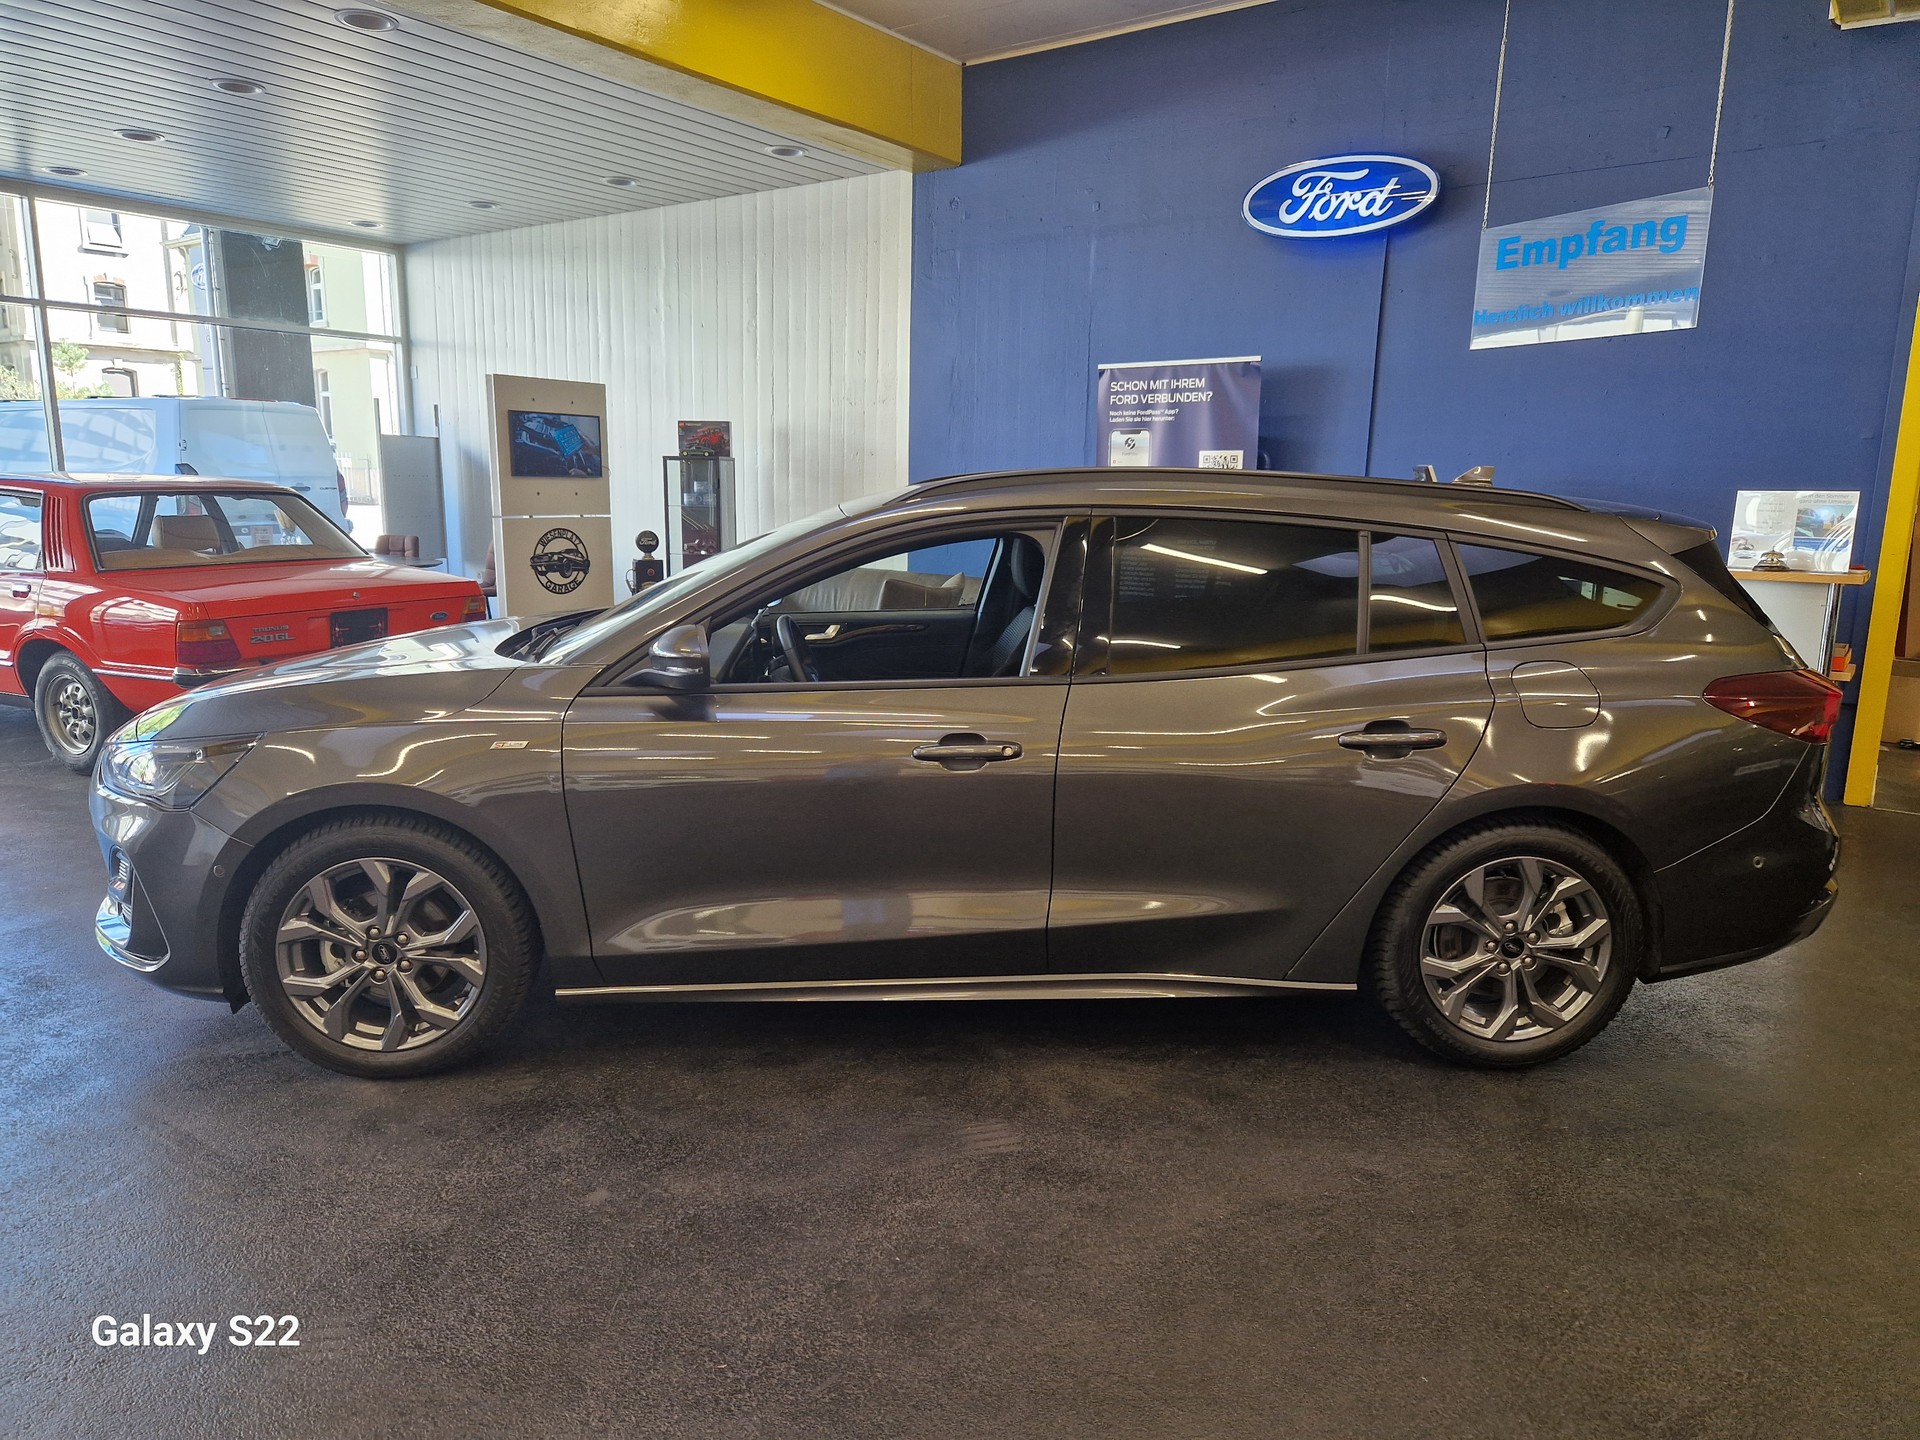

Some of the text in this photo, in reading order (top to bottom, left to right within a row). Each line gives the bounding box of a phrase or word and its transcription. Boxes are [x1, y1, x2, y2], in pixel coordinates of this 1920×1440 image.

[1278, 168, 1399, 225] Ford
[1495, 214, 1689, 271] Empfang
[1473, 287, 1700, 326] Herzlich willkommen
[1109, 391, 1213, 405] FORD VERBUNDEN?
[1110, 377, 1205, 392] SCHON MIT IHREM
[545, 579, 581, 593] GARAGE
